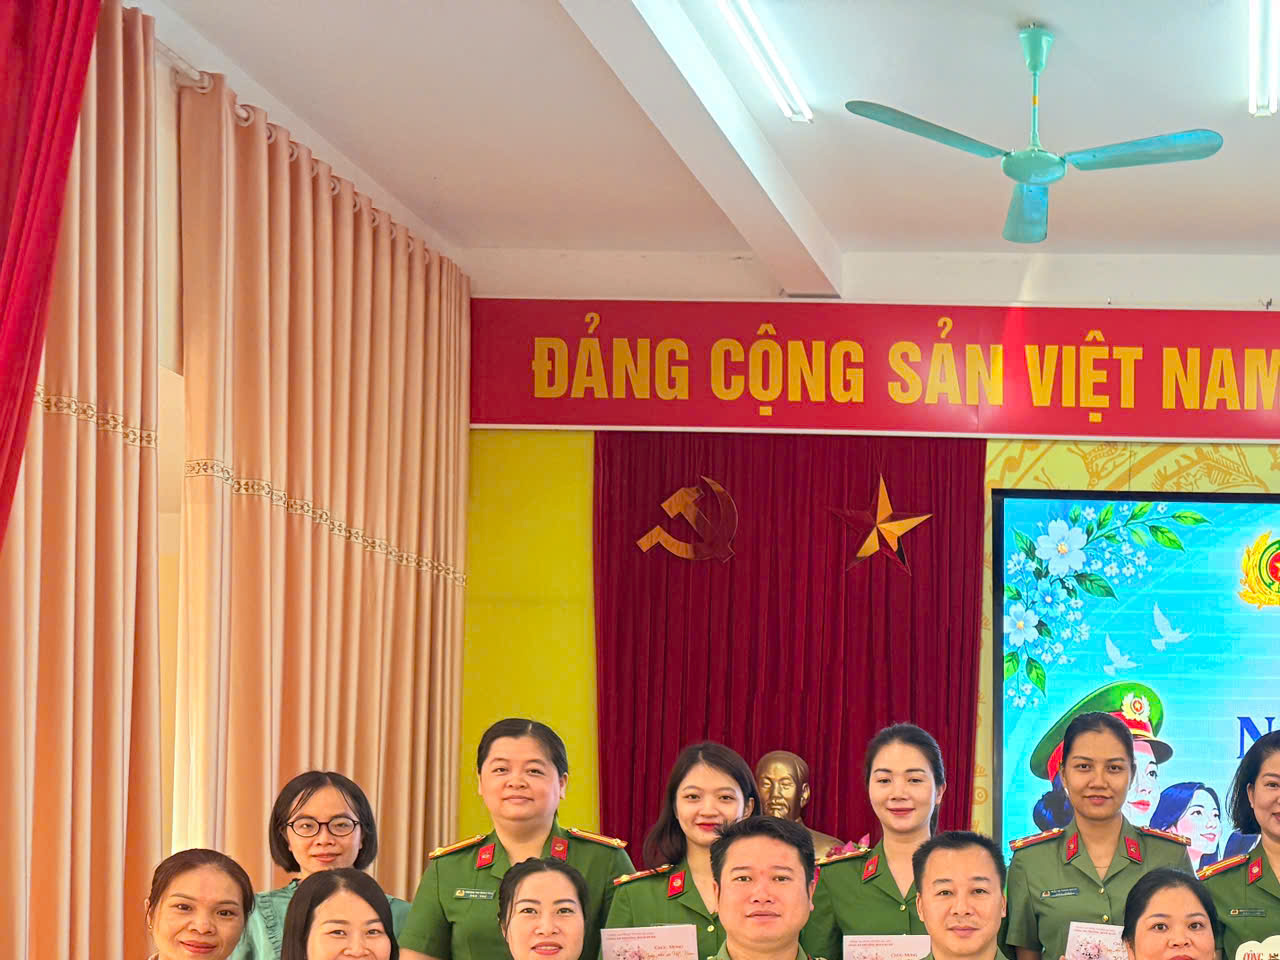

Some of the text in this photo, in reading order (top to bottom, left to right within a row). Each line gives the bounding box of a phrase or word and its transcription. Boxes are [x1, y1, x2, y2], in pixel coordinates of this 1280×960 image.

[532, 312, 689, 400] ĐẢNG
[711, 324, 864, 416] CỘNG
[888, 317, 1004, 408] SẢN
[1024, 330, 1143, 423] VIỆT
